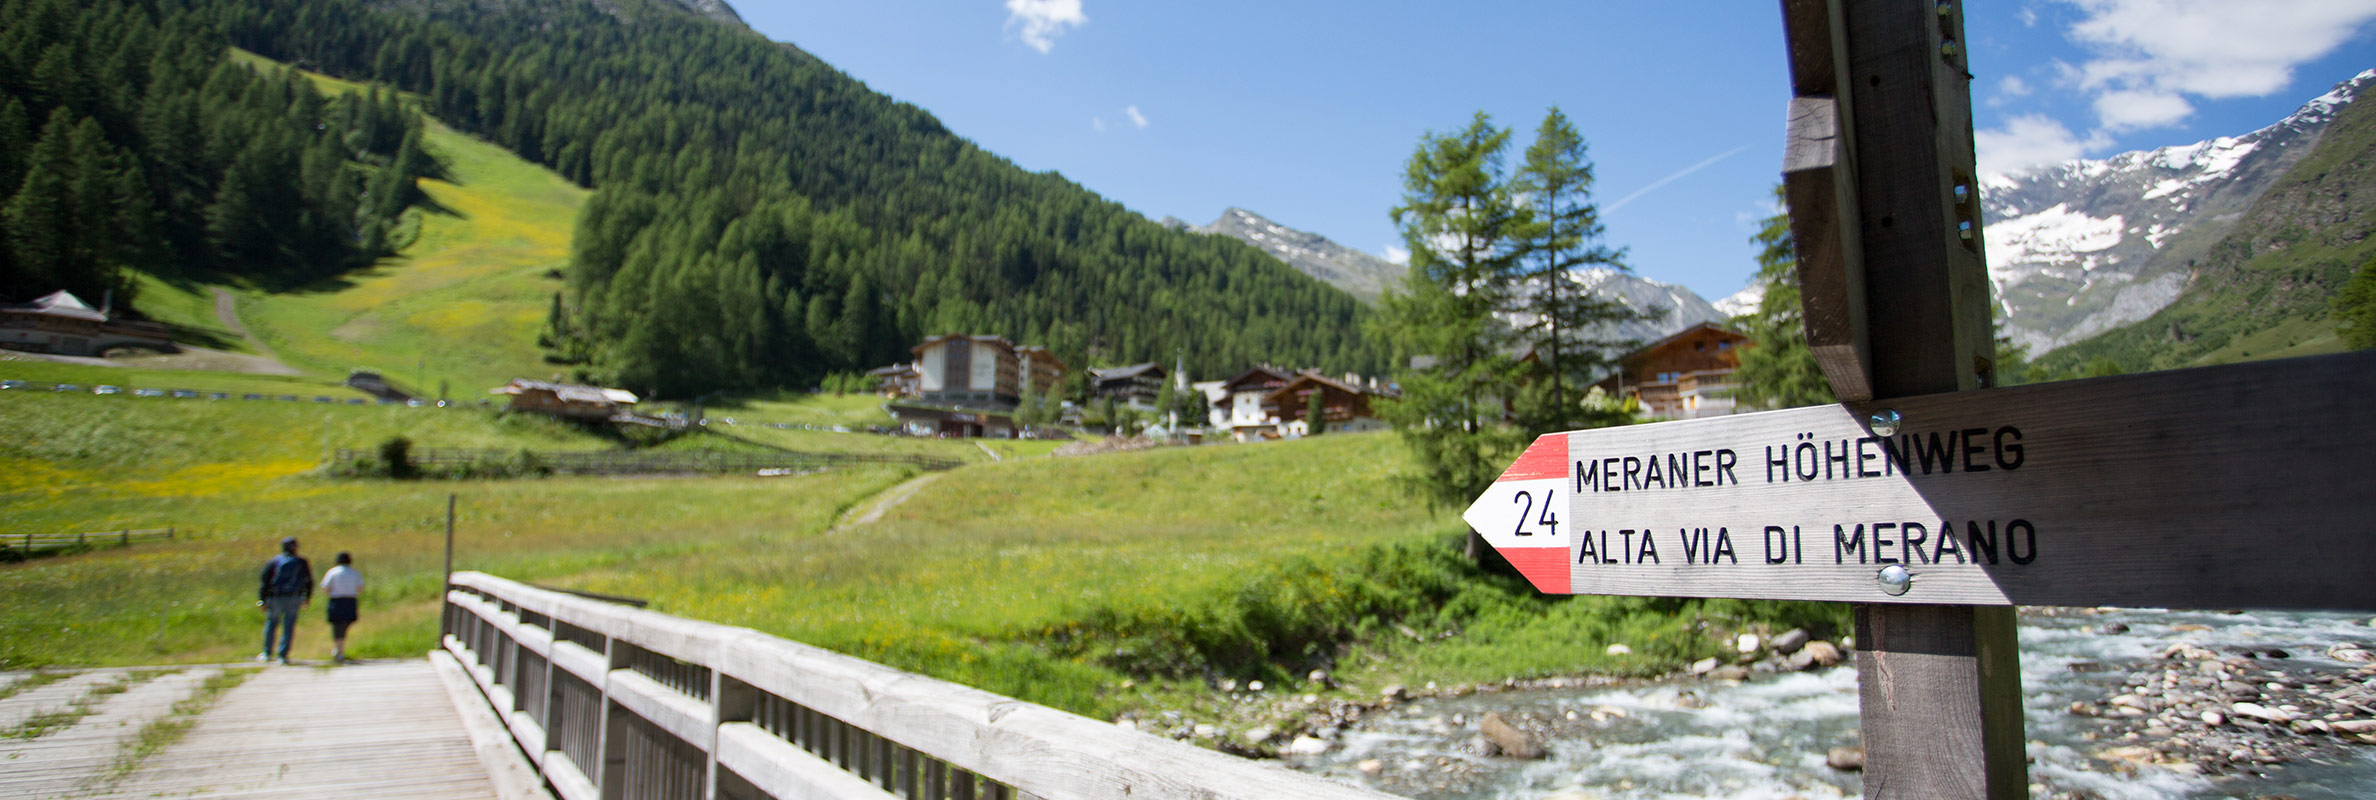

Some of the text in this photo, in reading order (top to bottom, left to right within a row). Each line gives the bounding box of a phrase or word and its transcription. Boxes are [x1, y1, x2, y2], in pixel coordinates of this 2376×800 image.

[1576, 425, 2025, 493] MERANER HÖHENWEG
[1513, 490, 1559, 537] 24
[1578, 518, 2038, 565] ALTA VIA DI MERANO
